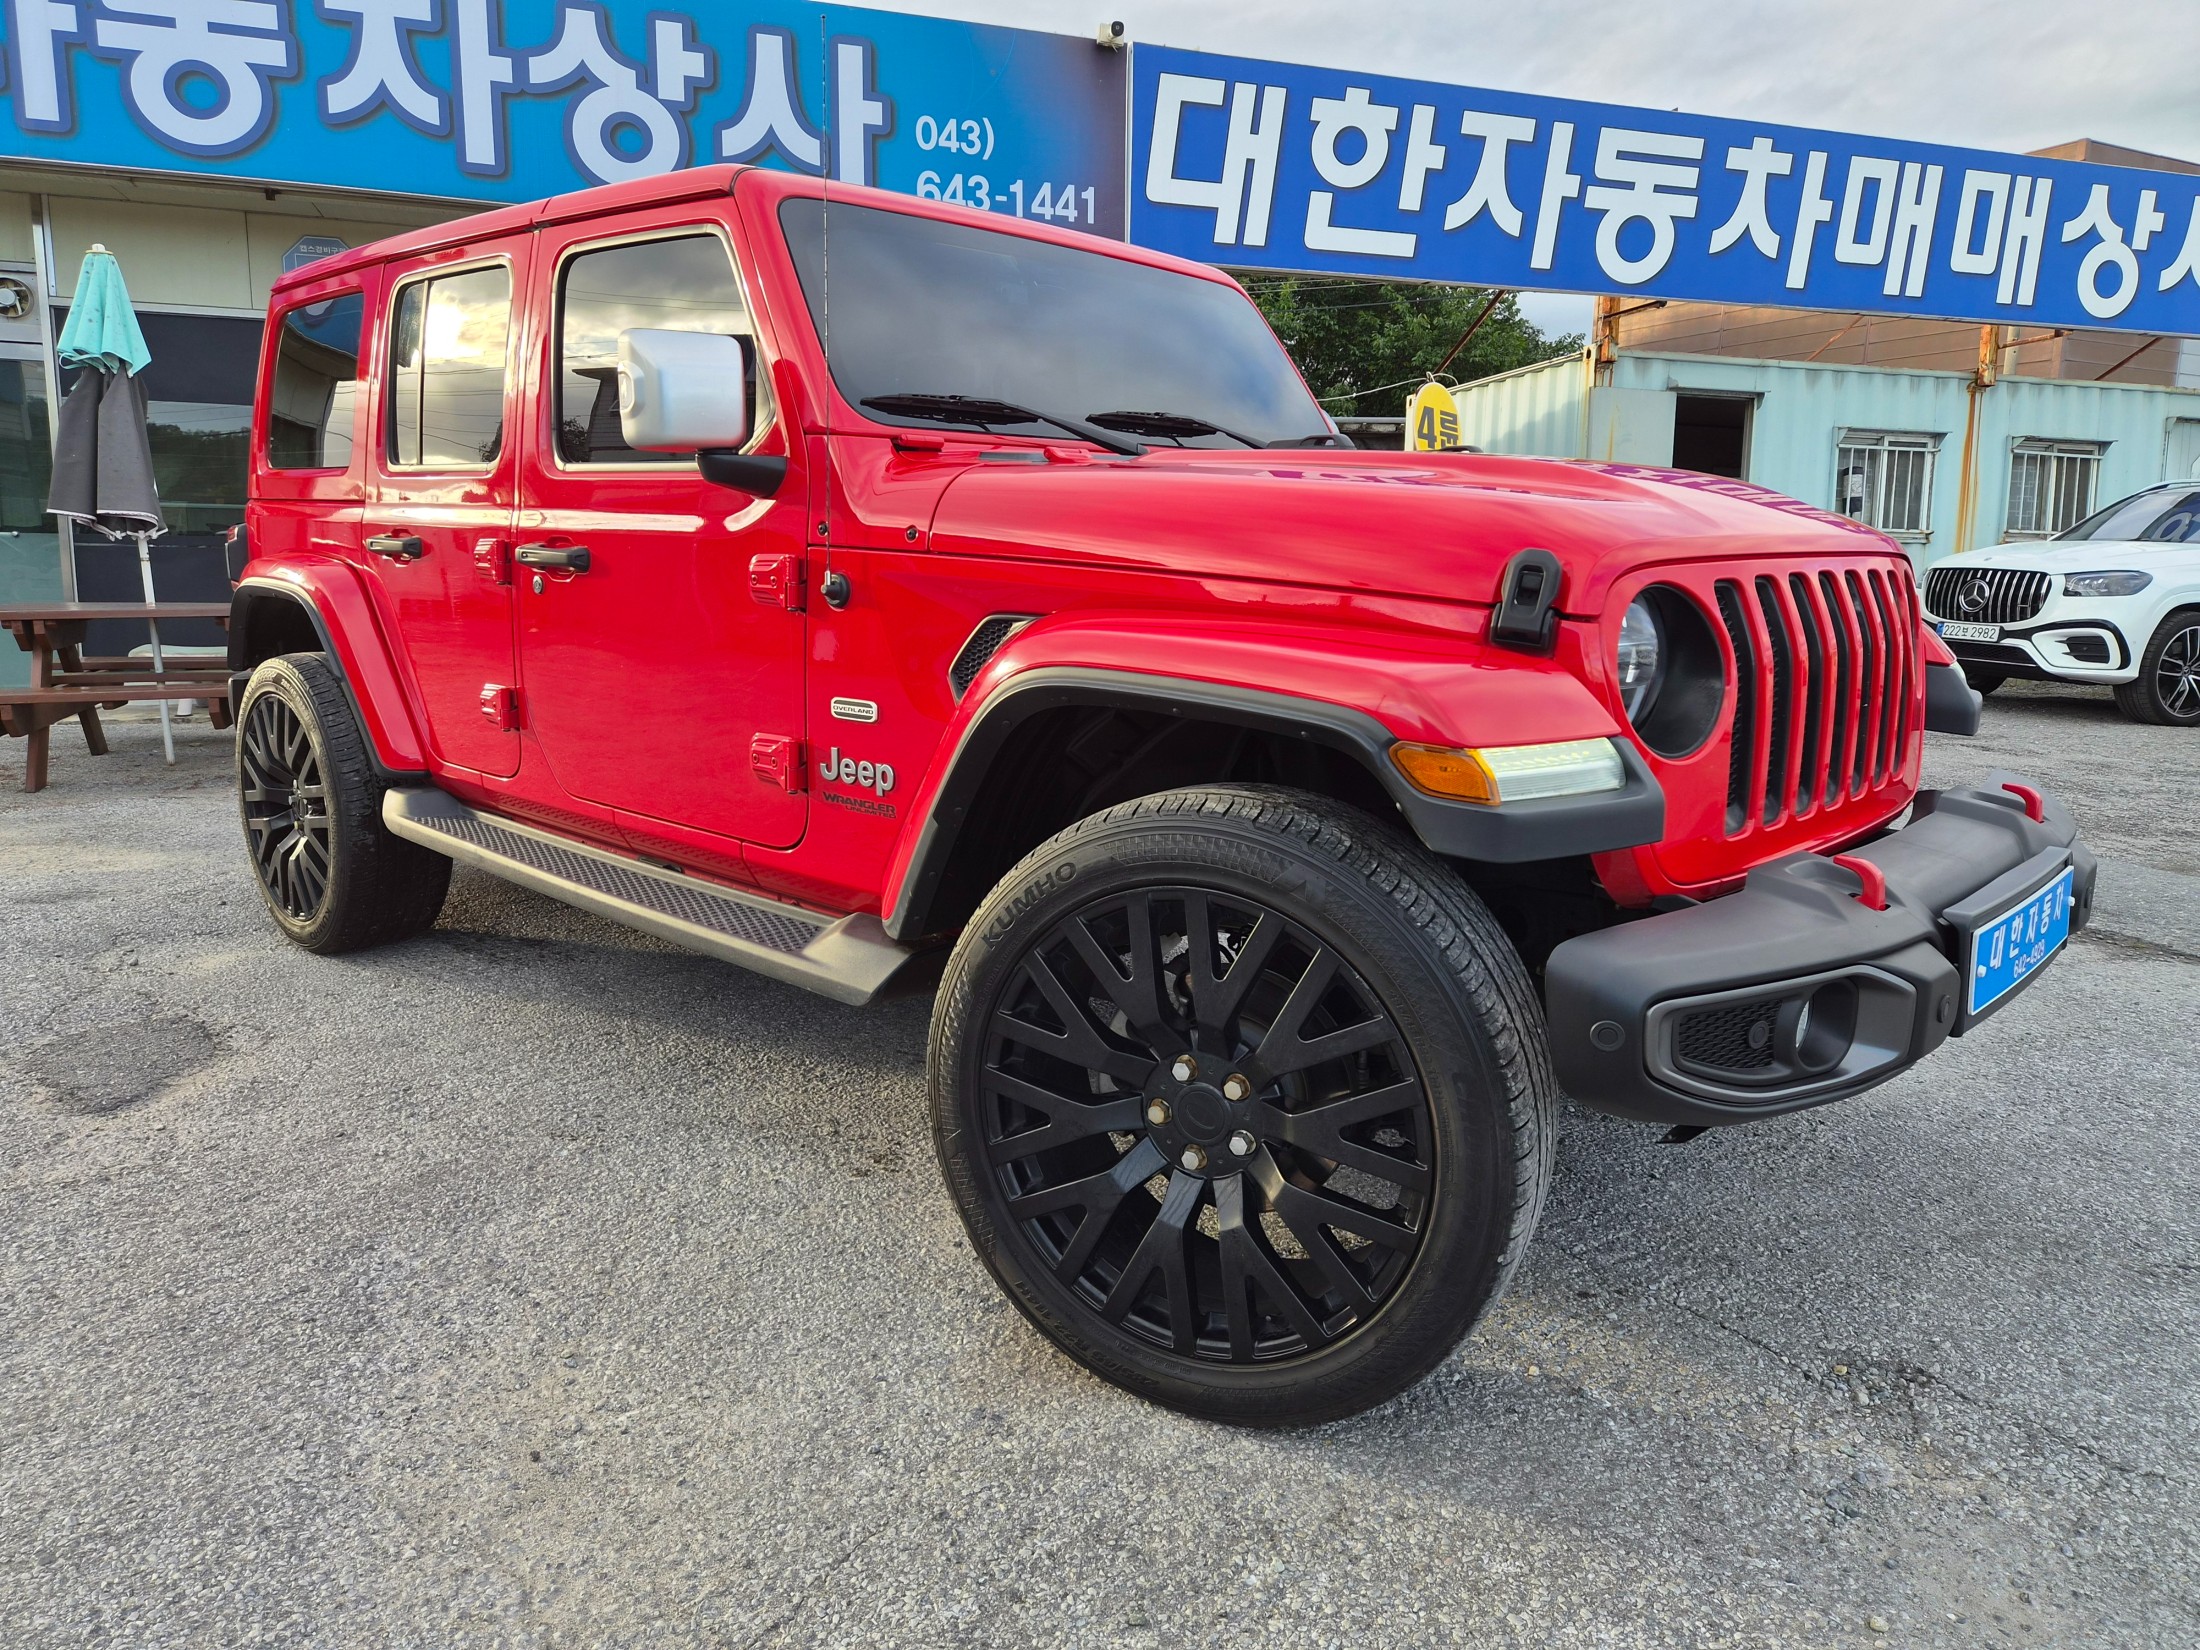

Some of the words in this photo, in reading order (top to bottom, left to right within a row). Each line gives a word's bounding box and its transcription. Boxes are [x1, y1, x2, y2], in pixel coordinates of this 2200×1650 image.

[915, 115, 994, 161] 043)
[916, 170, 1095, 224] 643-1441
[832, 704, 874, 715] OVERLAND
[820, 746, 895, 797] Jeep
[823, 791, 896, 814] WRANGLER
[845, 805, 897, 819] UNLIMITED
[981, 862, 1077, 951] KUMHO
